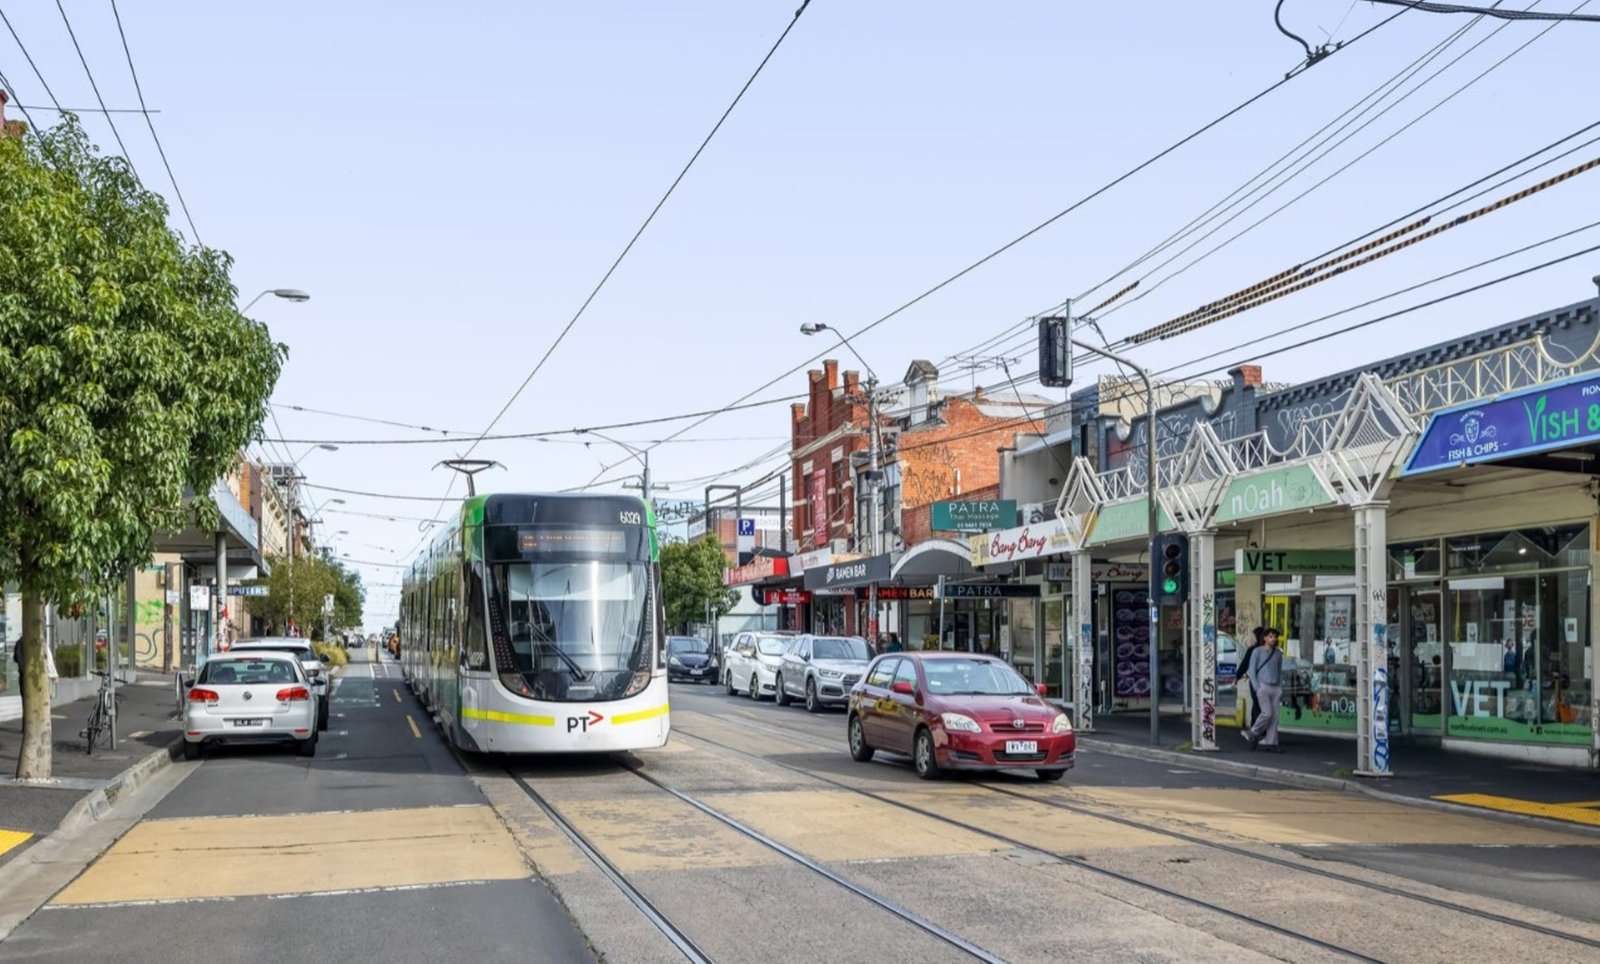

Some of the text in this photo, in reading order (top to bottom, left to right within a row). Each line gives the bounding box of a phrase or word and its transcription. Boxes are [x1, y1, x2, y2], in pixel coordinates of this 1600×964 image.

[1523, 394, 1579, 443] VISH
[1448, 441, 1499, 461] FISH & CHIPS
[949, 501, 1000, 513] PATRA
[620, 511, 641, 524] 6029
[991, 533, 1017, 560] Bang
[1018, 527, 1048, 555] Bang
[1246, 552, 1287, 571] VET
[836, 563, 867, 580] RAMEN BAR
[909, 587, 934, 598] BAR
[957, 585, 1001, 596] PATRA
[1331, 696, 1357, 712] nOa
[1450, 680, 1511, 718] VET
